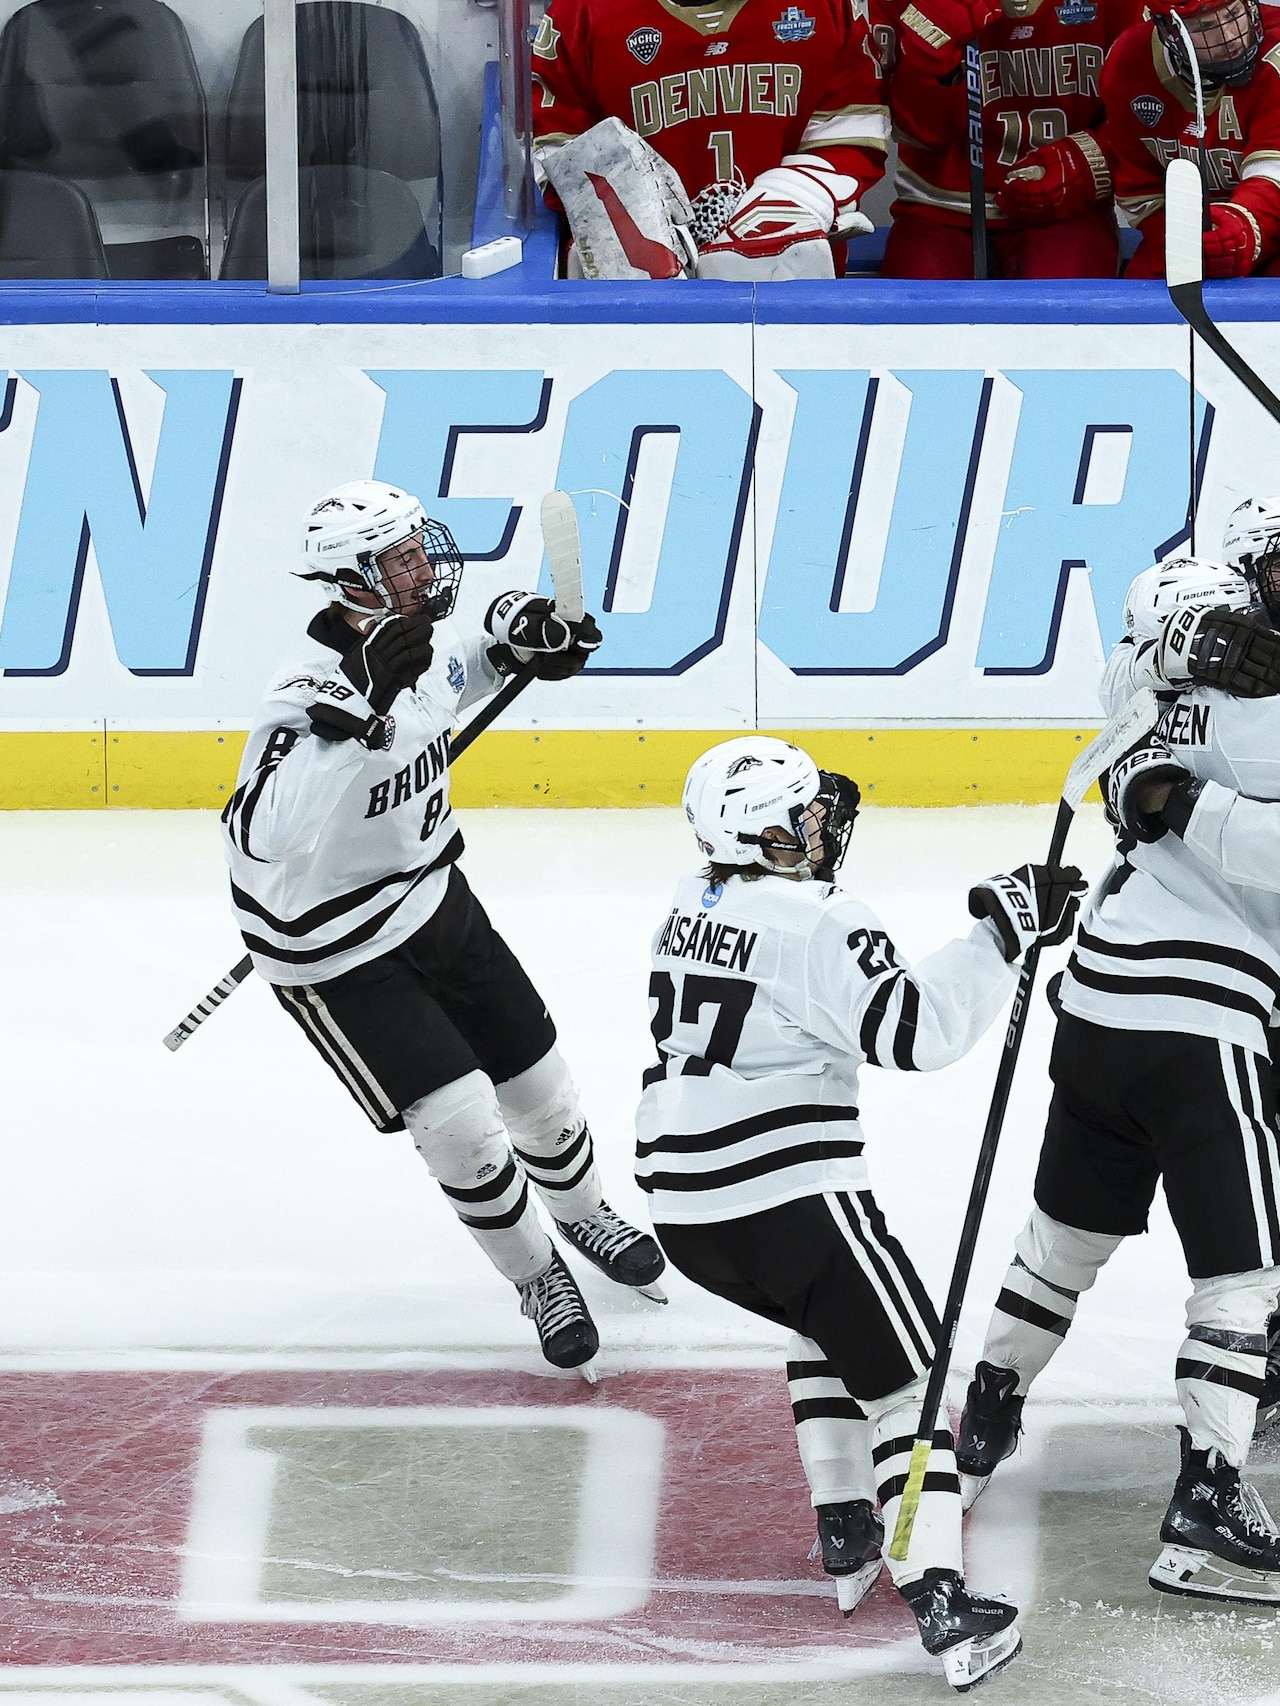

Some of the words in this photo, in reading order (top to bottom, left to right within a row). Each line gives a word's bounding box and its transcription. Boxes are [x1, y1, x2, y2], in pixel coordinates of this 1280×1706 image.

[628, 33, 660, 48] NCHC
[631, 63, 802, 137] DENVER
[979, 43, 1104, 107] ENVER
[1132, 101, 1163, 113] NCHC
[1219, 96, 1243, 140] A
[707, 131, 736, 181] 1
[0, 369, 243, 676] N
[362, 369, 1215, 676] FOUR
[1183, 590, 1216, 601] BAUER
[1169, 604, 1208, 656] BAU
[364, 727, 452, 819] BRONC
[420, 788, 444, 842] 8
[991, 874, 1037, 932] BAU
[657, 908, 758, 973] ÄISÄNEN
[846, 928, 901, 980] 27
[971, 1606, 1004, 1616] BAUER
